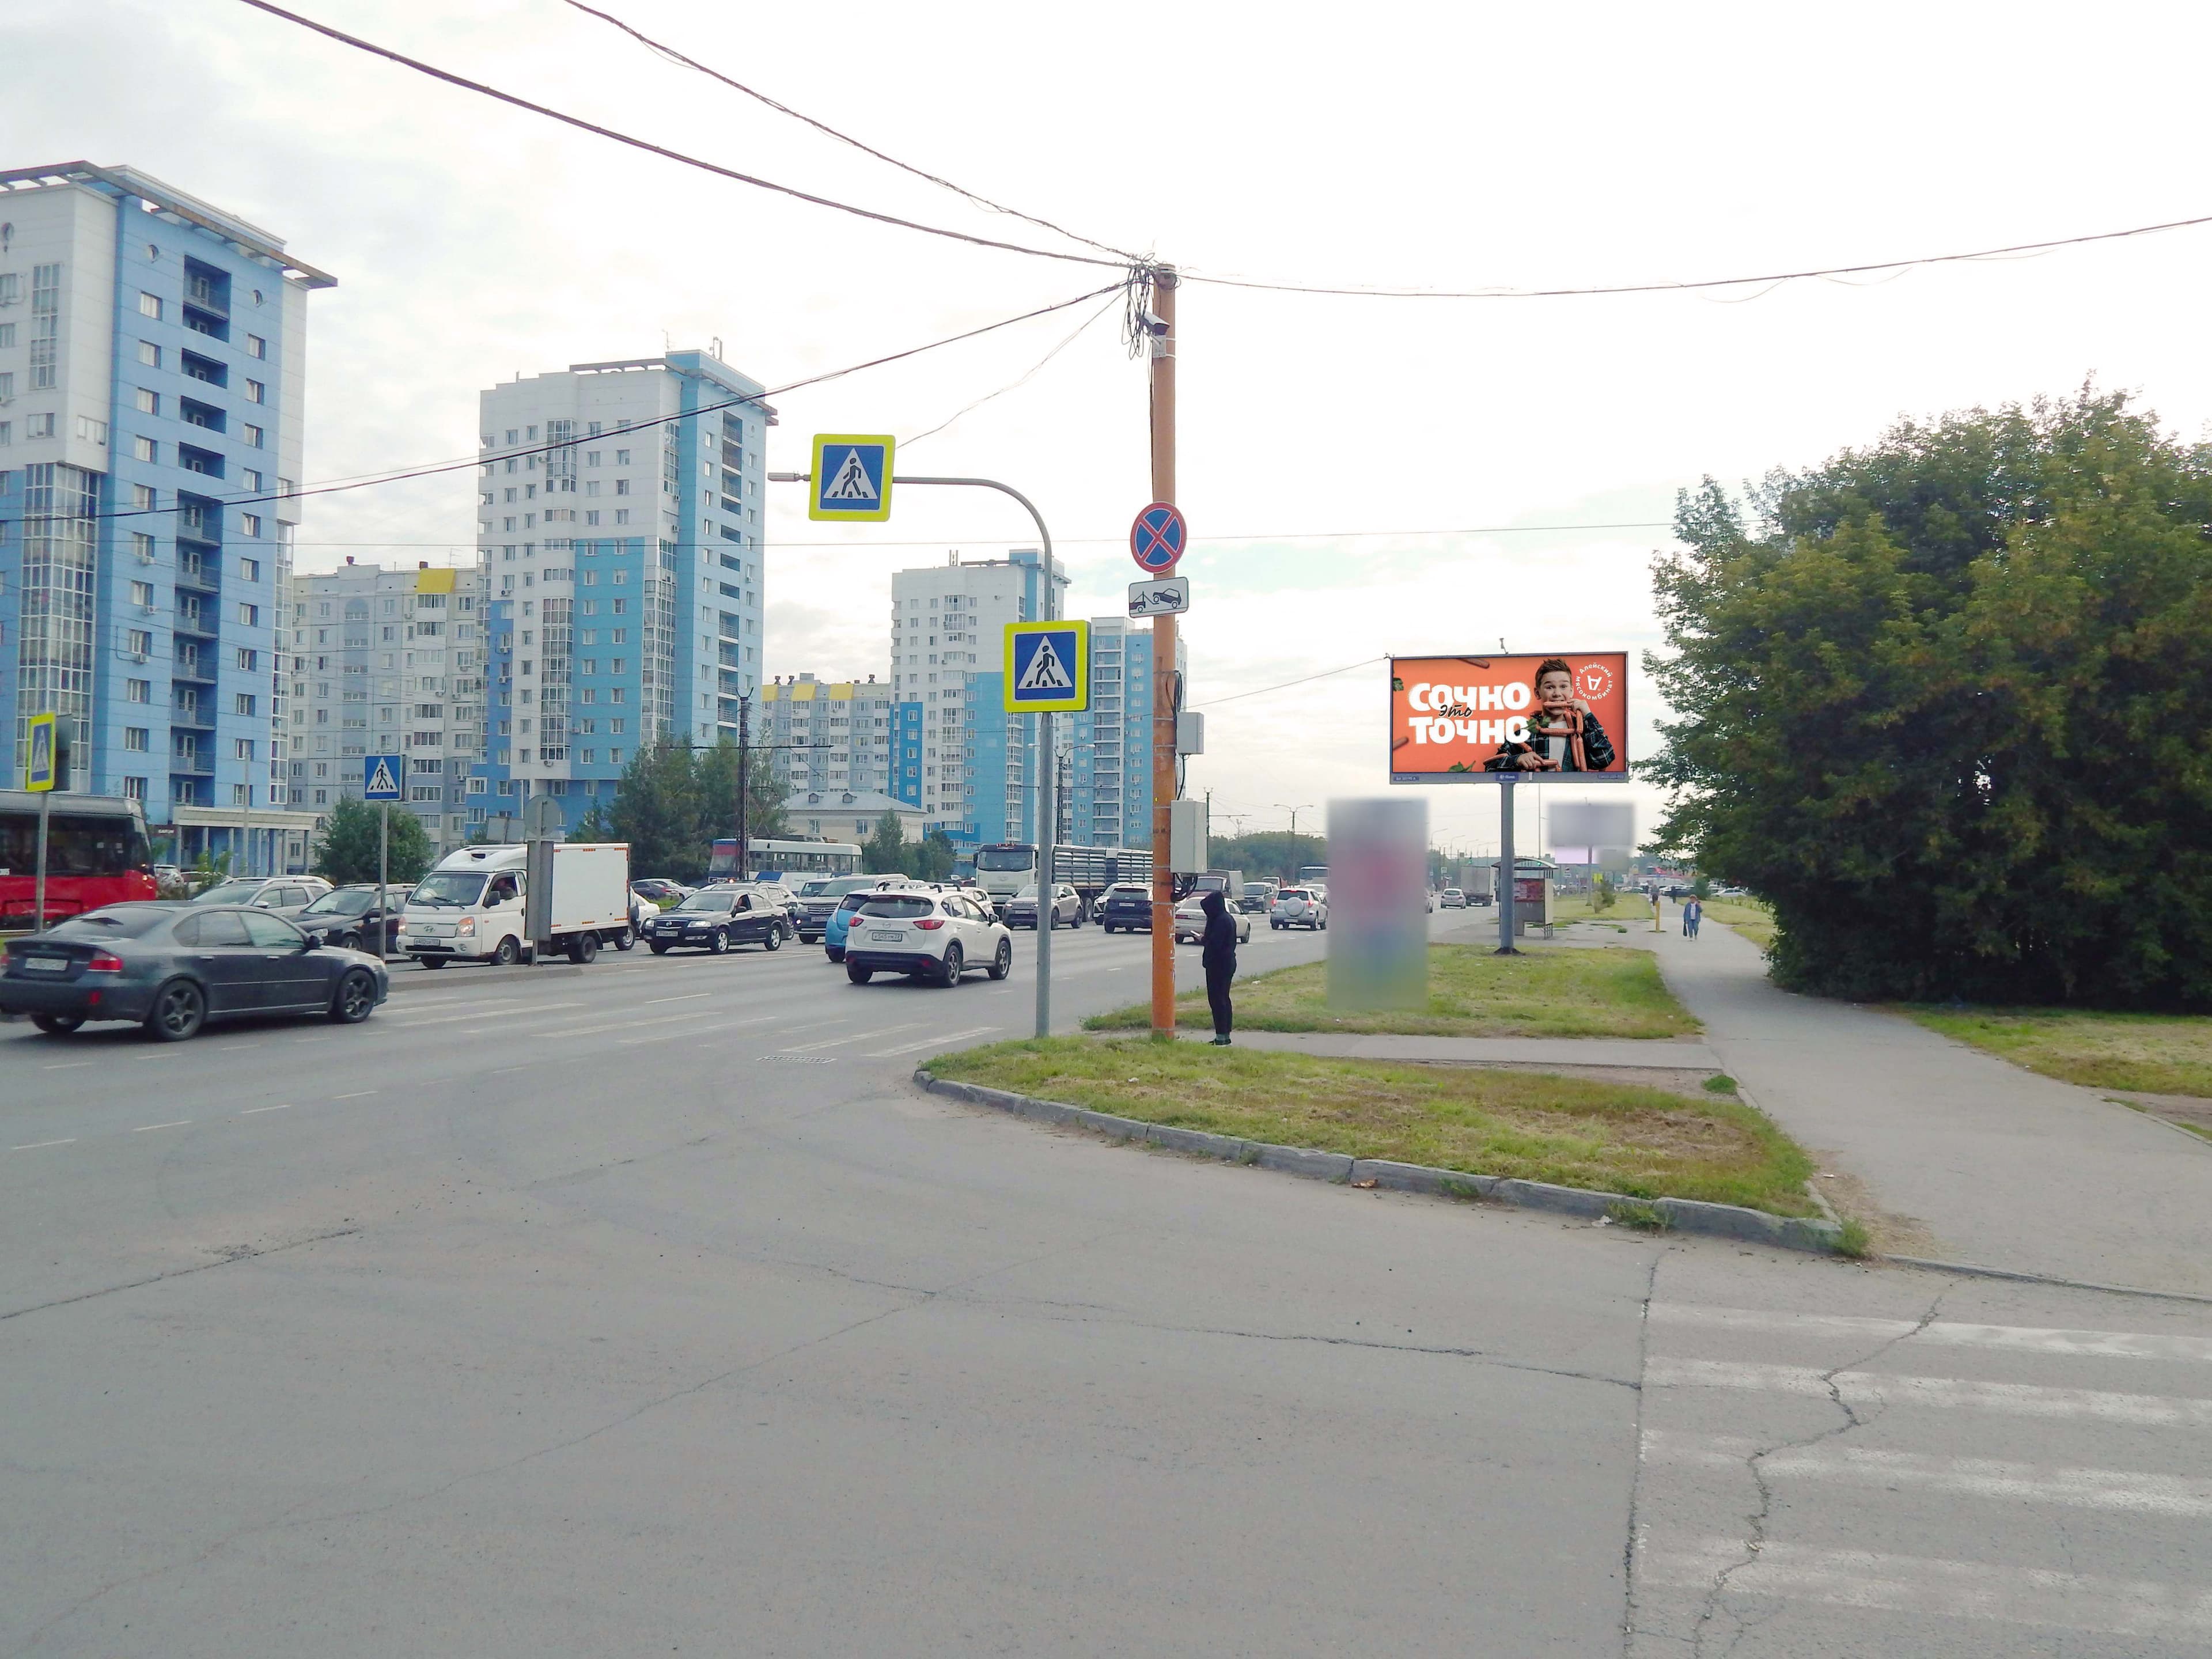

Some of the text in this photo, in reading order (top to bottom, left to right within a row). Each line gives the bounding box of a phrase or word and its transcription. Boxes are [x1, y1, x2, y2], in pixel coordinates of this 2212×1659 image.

[1575, 662, 1613, 700] Алейский мясокомбинат
[1408, 682, 1531, 711] СОЧНО
[1438, 704, 1473, 717] это
[1408, 715, 1531, 744] ТОЧНО
